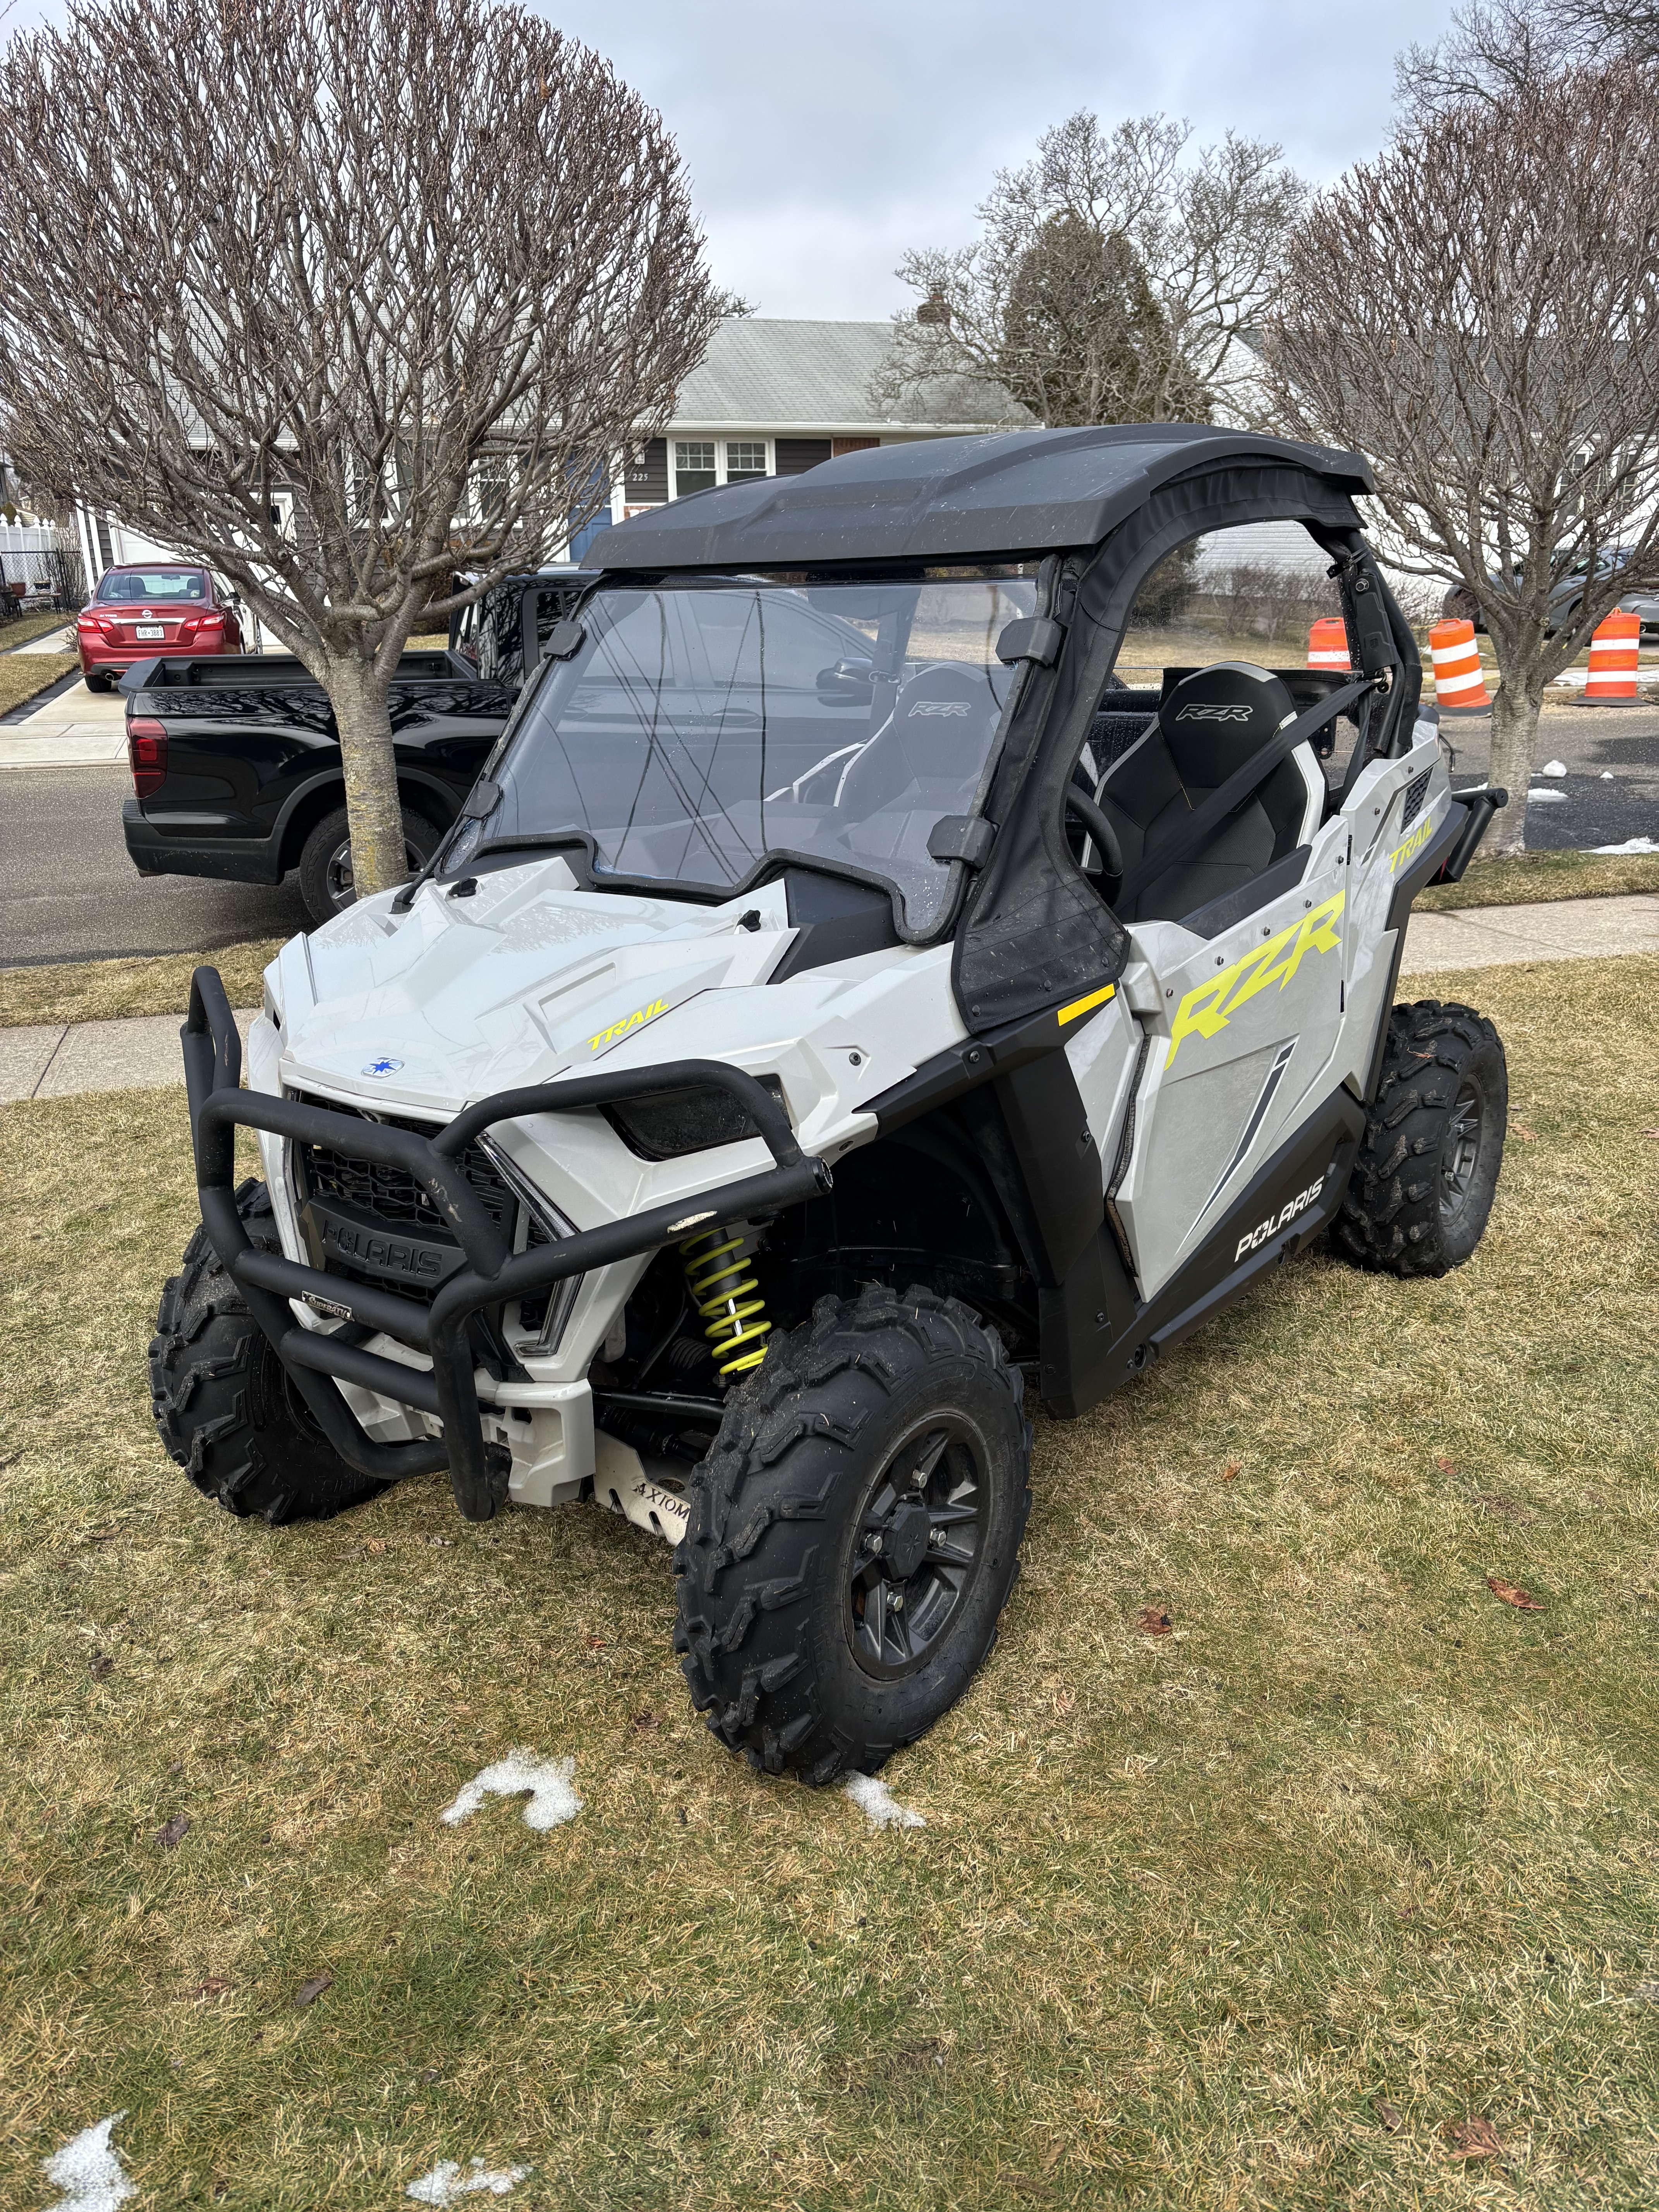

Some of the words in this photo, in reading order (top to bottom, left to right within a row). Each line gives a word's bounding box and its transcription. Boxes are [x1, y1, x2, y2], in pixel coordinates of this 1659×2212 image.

[632, 473, 648, 481] 225
[908, 701, 971, 717] RZR
[1175, 704, 1253, 721] RZR
[1388, 816, 1432, 874] TRAIL
[1164, 888, 1345, 1071] RZR
[587, 998, 668, 1051] TRAIL
[1234, 1175, 1325, 1262] POLARIS
[321, 1220, 442, 1278] POLARIS
[631, 1482, 690, 1520] AXIOM
